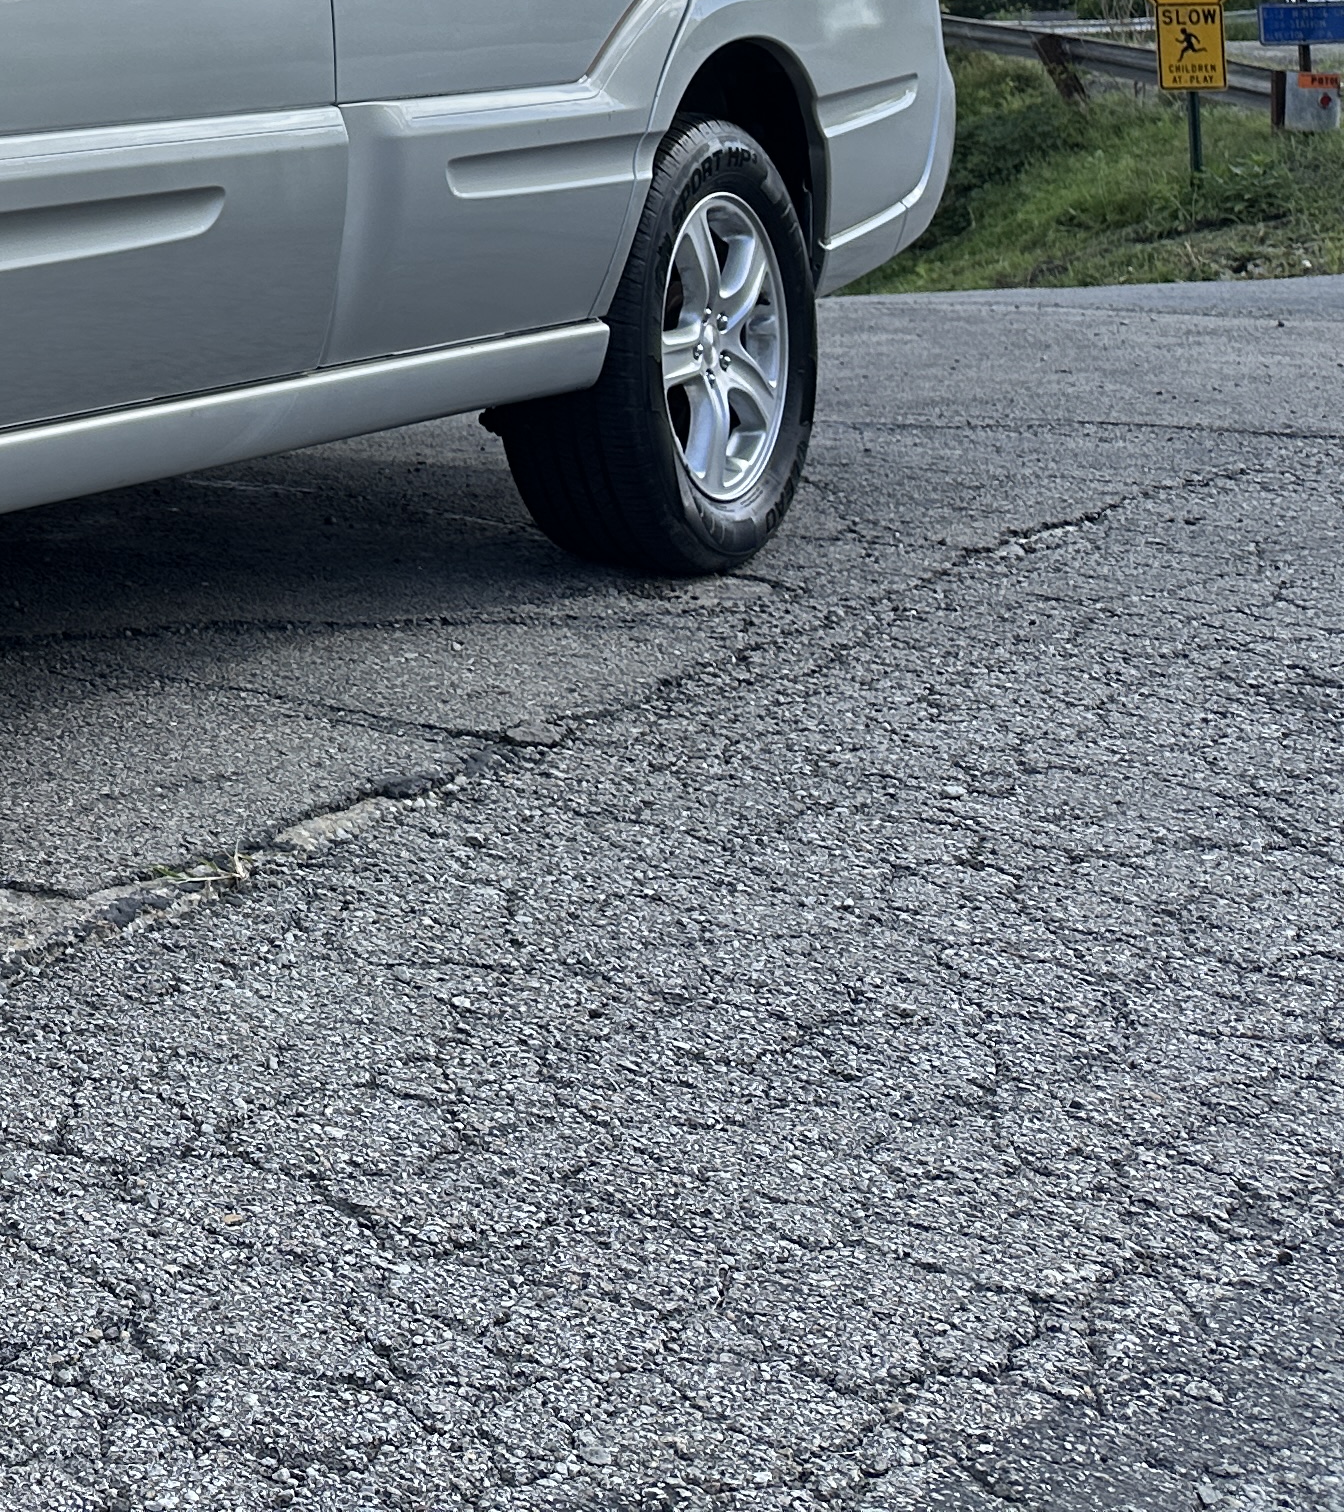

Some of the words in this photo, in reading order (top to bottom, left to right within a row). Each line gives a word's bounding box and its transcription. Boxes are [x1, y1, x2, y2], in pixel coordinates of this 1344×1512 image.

[1162, 9, 1217, 25] SLOW
[1168, 64, 1217, 74] CHILDREN
[1172, 75, 1182, 84] AT
[1189, 75, 1214, 84] PLAY
